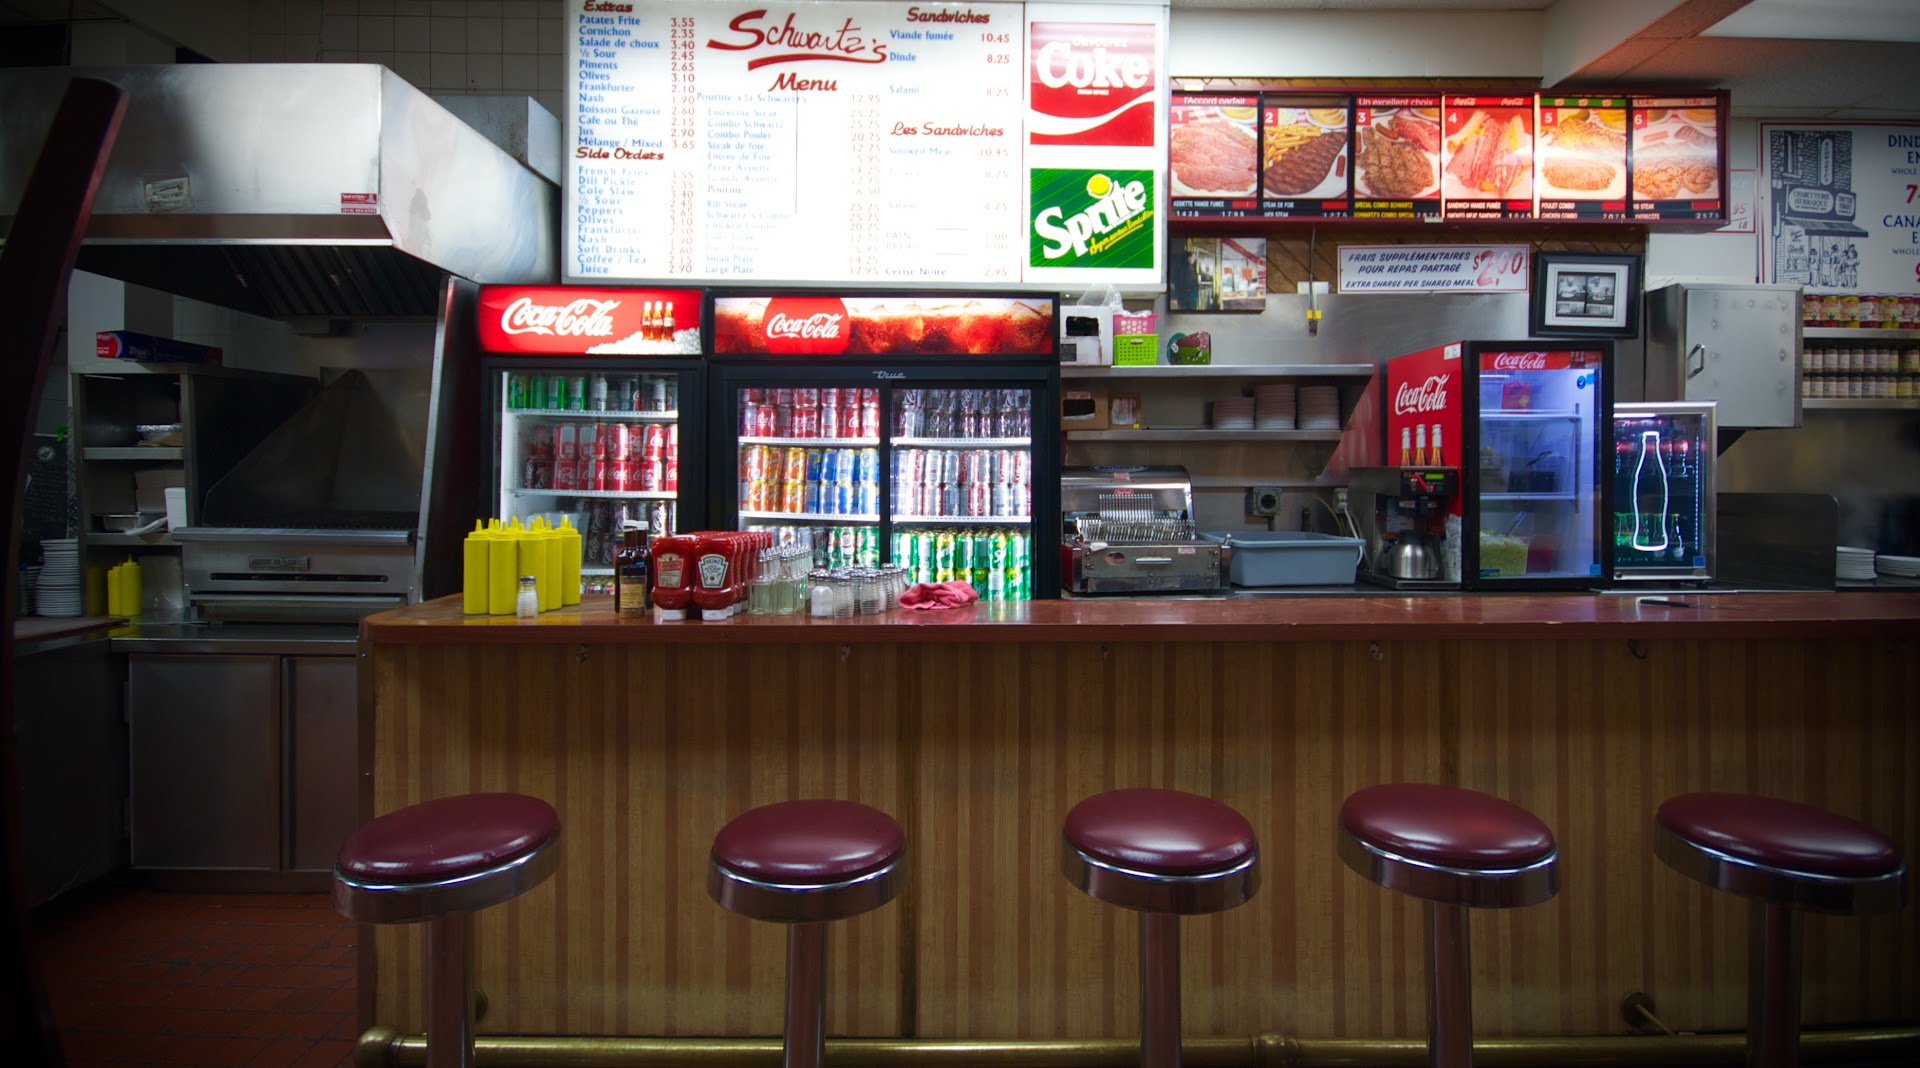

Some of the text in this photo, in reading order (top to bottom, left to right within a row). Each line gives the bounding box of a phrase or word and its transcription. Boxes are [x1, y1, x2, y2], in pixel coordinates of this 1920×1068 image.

[583, 1, 633, 12] Extras
[906, 6, 990, 24] Sandwiches
[579, 15, 694, 28] Patates Frite 3.55
[579, 26, 694, 38] Cornichon 2.35
[705, 9, 887, 64] Schwartz's
[890, 30, 1010, 43] Viande fumée 10.45
[579, 37, 695, 50] Salade de choux 3.40
[594, 50, 694, 60] Sour 2.45
[890, 52, 1010, 64] Dinde 8.25
[579, 60, 694, 72] Piments 2.65
[1036, 41, 1150, 88] Coke
[579, 71, 695, 82] Olives 3.10
[768, 72, 837, 92] Menu
[579, 82, 695, 94] Frankfurter 2.10
[890, 84, 1009, 96] Salami 8.25
[579, 93, 695, 104] Nash 1.90
[696, 92, 732, 102] Poutine
[579, 104, 694, 116] Boisson Gazeuse 2.60
[578, 116, 600, 126] Cafe
[622, 116, 638, 126] Thé
[672, 118, 694, 127] 2.15
[1266, 112, 1274, 124] 2
[1358, 112, 1366, 123] 3
[1448, 112, 1458, 124] 4
[1544, 113, 1552, 124] 5
[1634, 114, 1642, 124] 6
[708, 119, 740, 128] Combo
[890, 122, 1004, 136] Les Sandwiches
[578, 126, 694, 138] Jus 2.90
[708, 130, 880, 142] Combo Poulet 20.75
[578, 136, 695, 150] Mélange Mixed 3.65
[708, 141, 731, 150] Steak
[735, 142, 746, 150] de
[748, 142, 764, 150] foie
[576, 146, 664, 160] Side Orders
[980, 148, 1008, 156] 10.45
[578, 166, 616, 176] French
[1892, 168, 1917, 176] WHOLE
[578, 176, 636, 186] Dill Pickle
[578, 186, 604, 196] Cole
[610, 187, 634, 196] Slaw
[595, 196, 621, 205] Sour
[578, 206, 693, 217] Peppers 2.65
[984, 202, 1008, 211] 8.25
[578, 215, 614, 224] Olives
[1034, 180, 1146, 258] Sprite
[578, 235, 606, 244] Nash
[578, 244, 602, 254] Soft
[606, 245, 640, 254] Drinks
[577, 254, 692, 265] Coffee Tea 2.15
[1348, 252, 1470, 262] FRAIS SUPPLÉMENTAIRES
[580, 264, 692, 274] Juice 2.90
[984, 268, 1008, 276] 2.95
[1358, 262, 1461, 274] POUR REPAS PARTAGÉ
[1346, 280, 1371, 288] EXTRA
[1372, 280, 1402, 288] CHARGE
[1403, 280, 1419, 288] PER
[1421, 280, 1452, 288] SHARED
[766, 312, 844, 339] Coca-Cola
[1494, 351, 1548, 370] Coca-Cola
[1395, 373, 1451, 415] Coca-Cola
